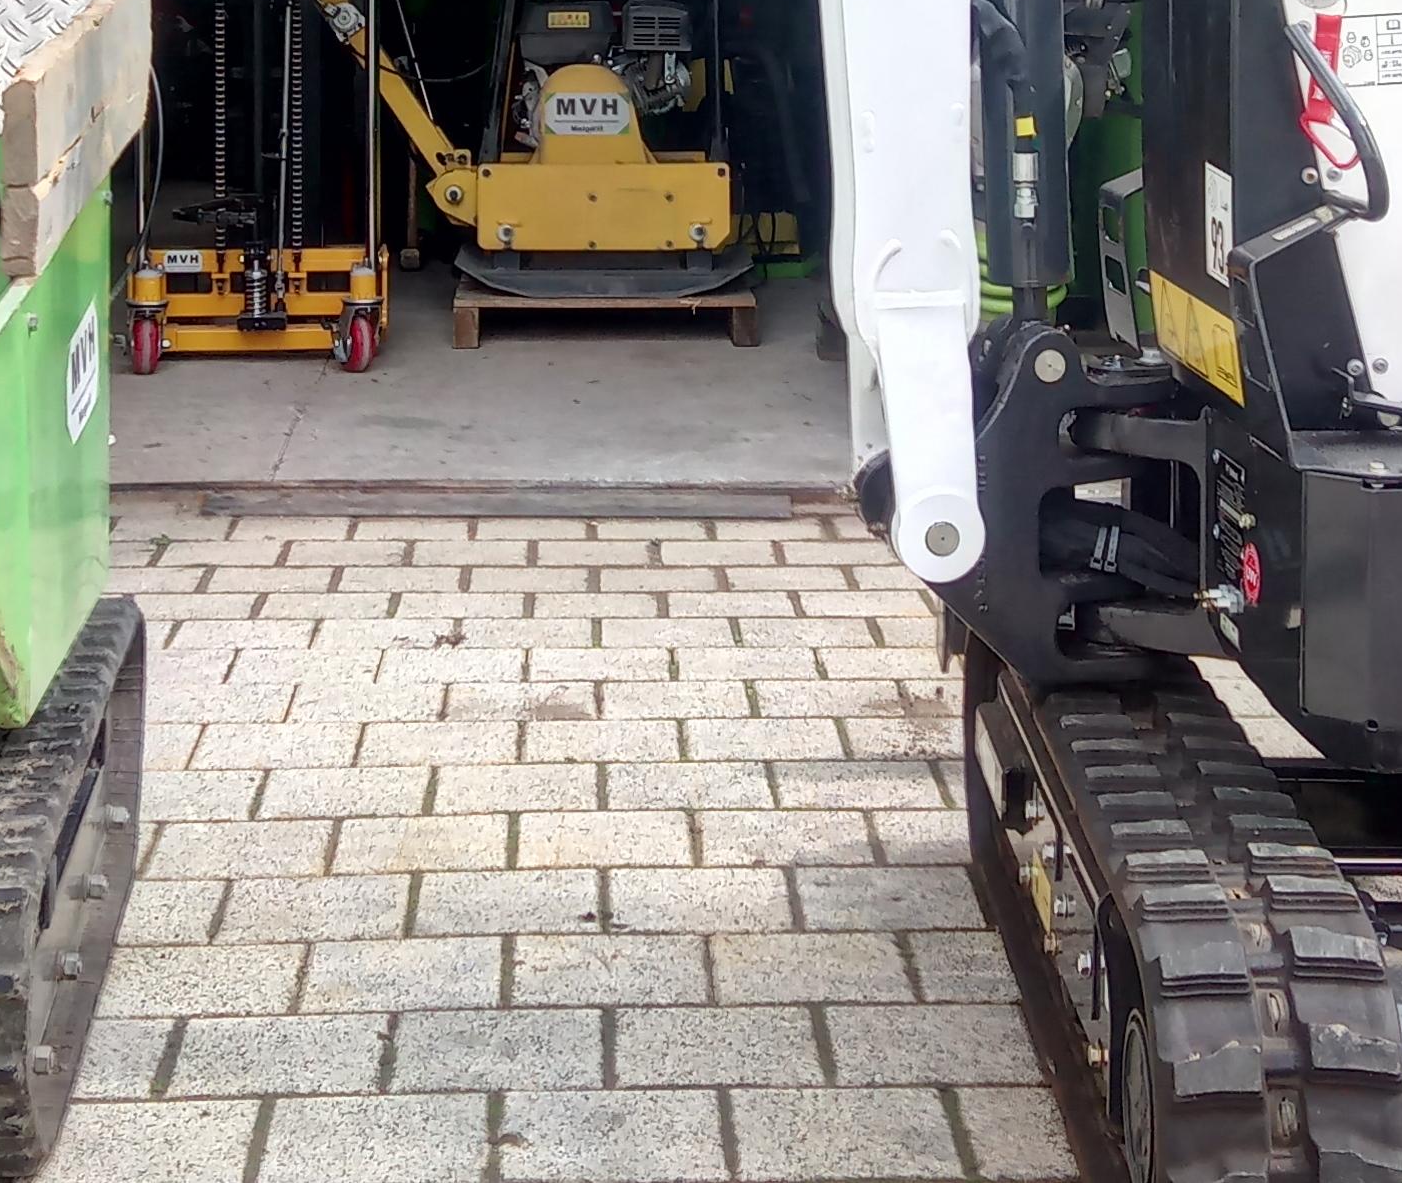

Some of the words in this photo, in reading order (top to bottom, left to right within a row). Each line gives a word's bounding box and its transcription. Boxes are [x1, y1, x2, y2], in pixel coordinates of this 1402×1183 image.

[556, 98, 618, 115] MVH
[167, 254, 199, 264] MVH
[71, 315, 96, 394] MVH
